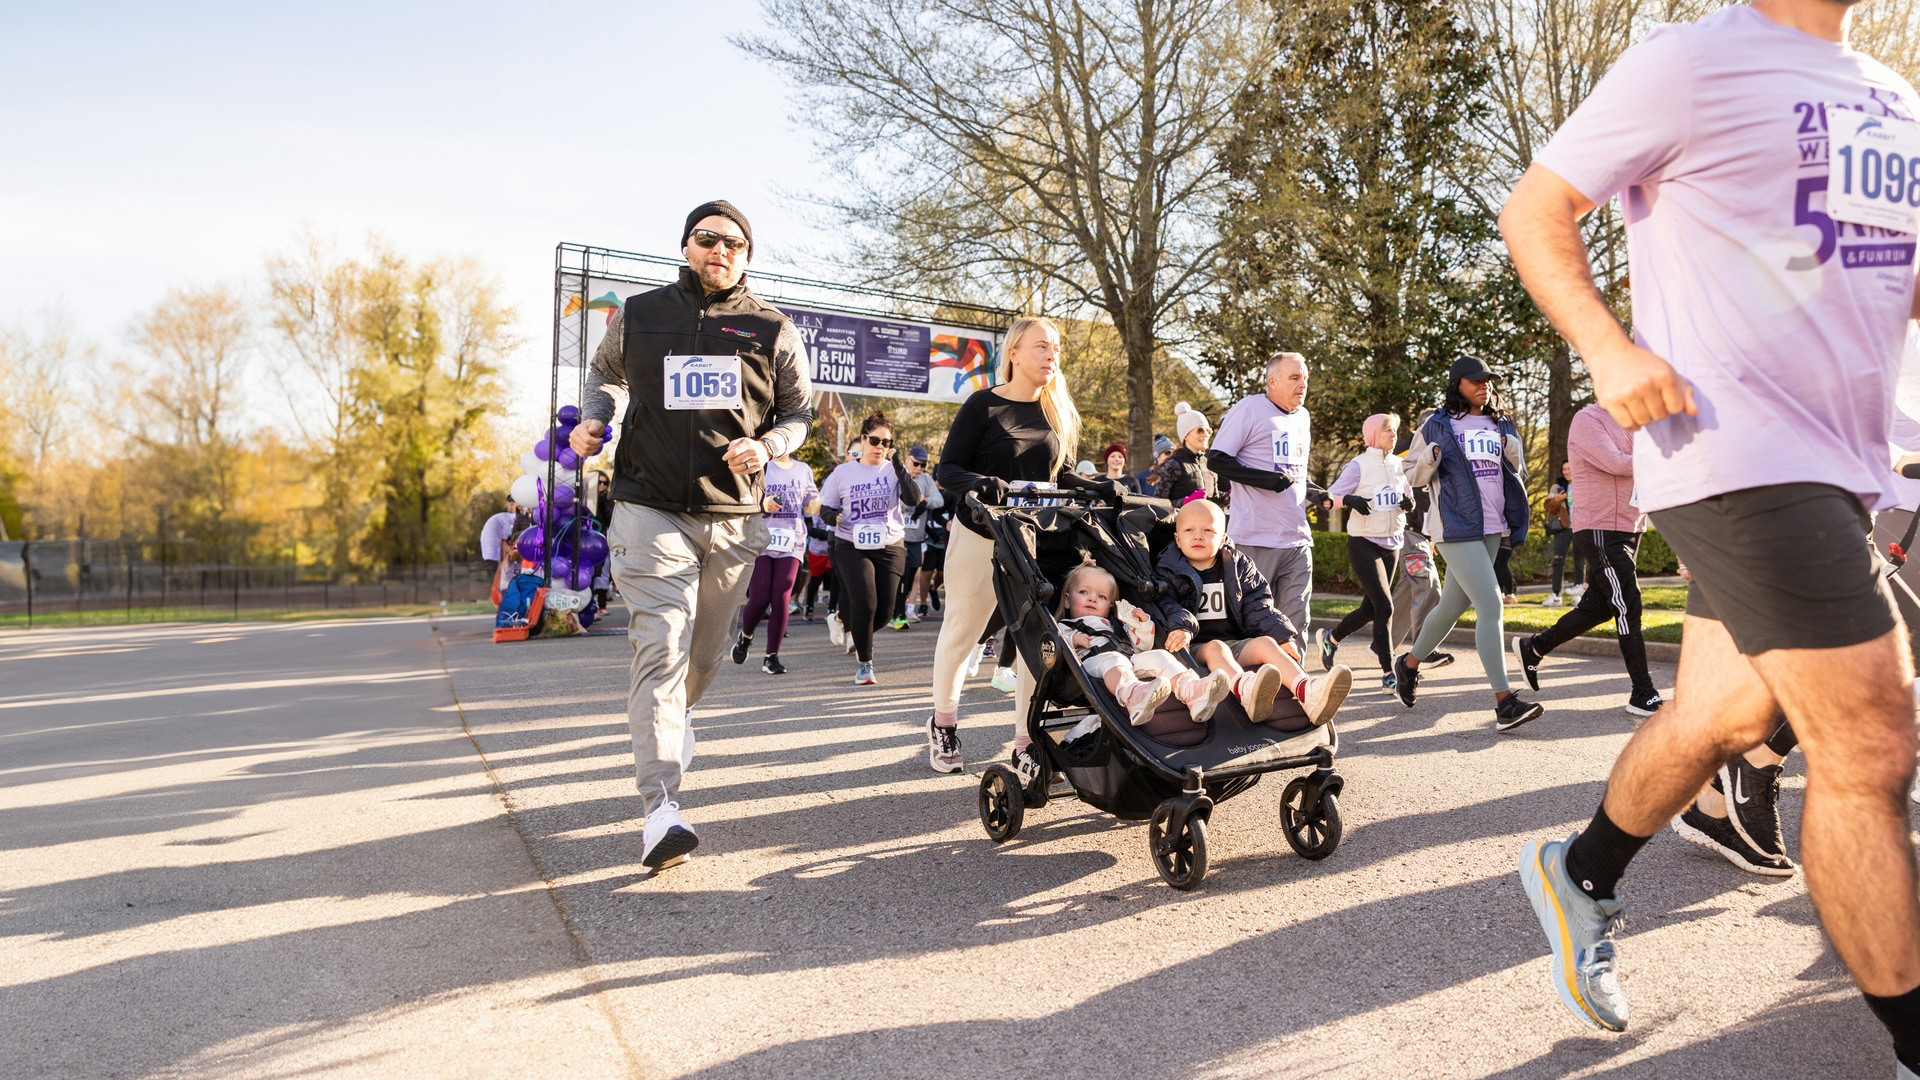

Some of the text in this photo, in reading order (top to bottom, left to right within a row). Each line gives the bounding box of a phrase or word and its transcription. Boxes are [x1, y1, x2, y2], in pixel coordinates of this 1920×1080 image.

[1839, 145, 1920, 207] 1098
[819, 350, 829, 363] &
[831, 350, 856, 366] FUN
[820, 363, 856, 384] RUN
[669, 371, 737, 397] 1053
[1468, 439, 1501, 457] 1105
[766, 484, 787, 492] 2024
[850, 483, 871, 493] 2024
[850, 498, 871, 521] 5K
[872, 500, 890, 512] RUN
[771, 534, 790, 547] 917
[858, 531, 881, 544] 915
[1198, 591, 1223, 613] 20
[1227, 745, 1247, 754] baby
